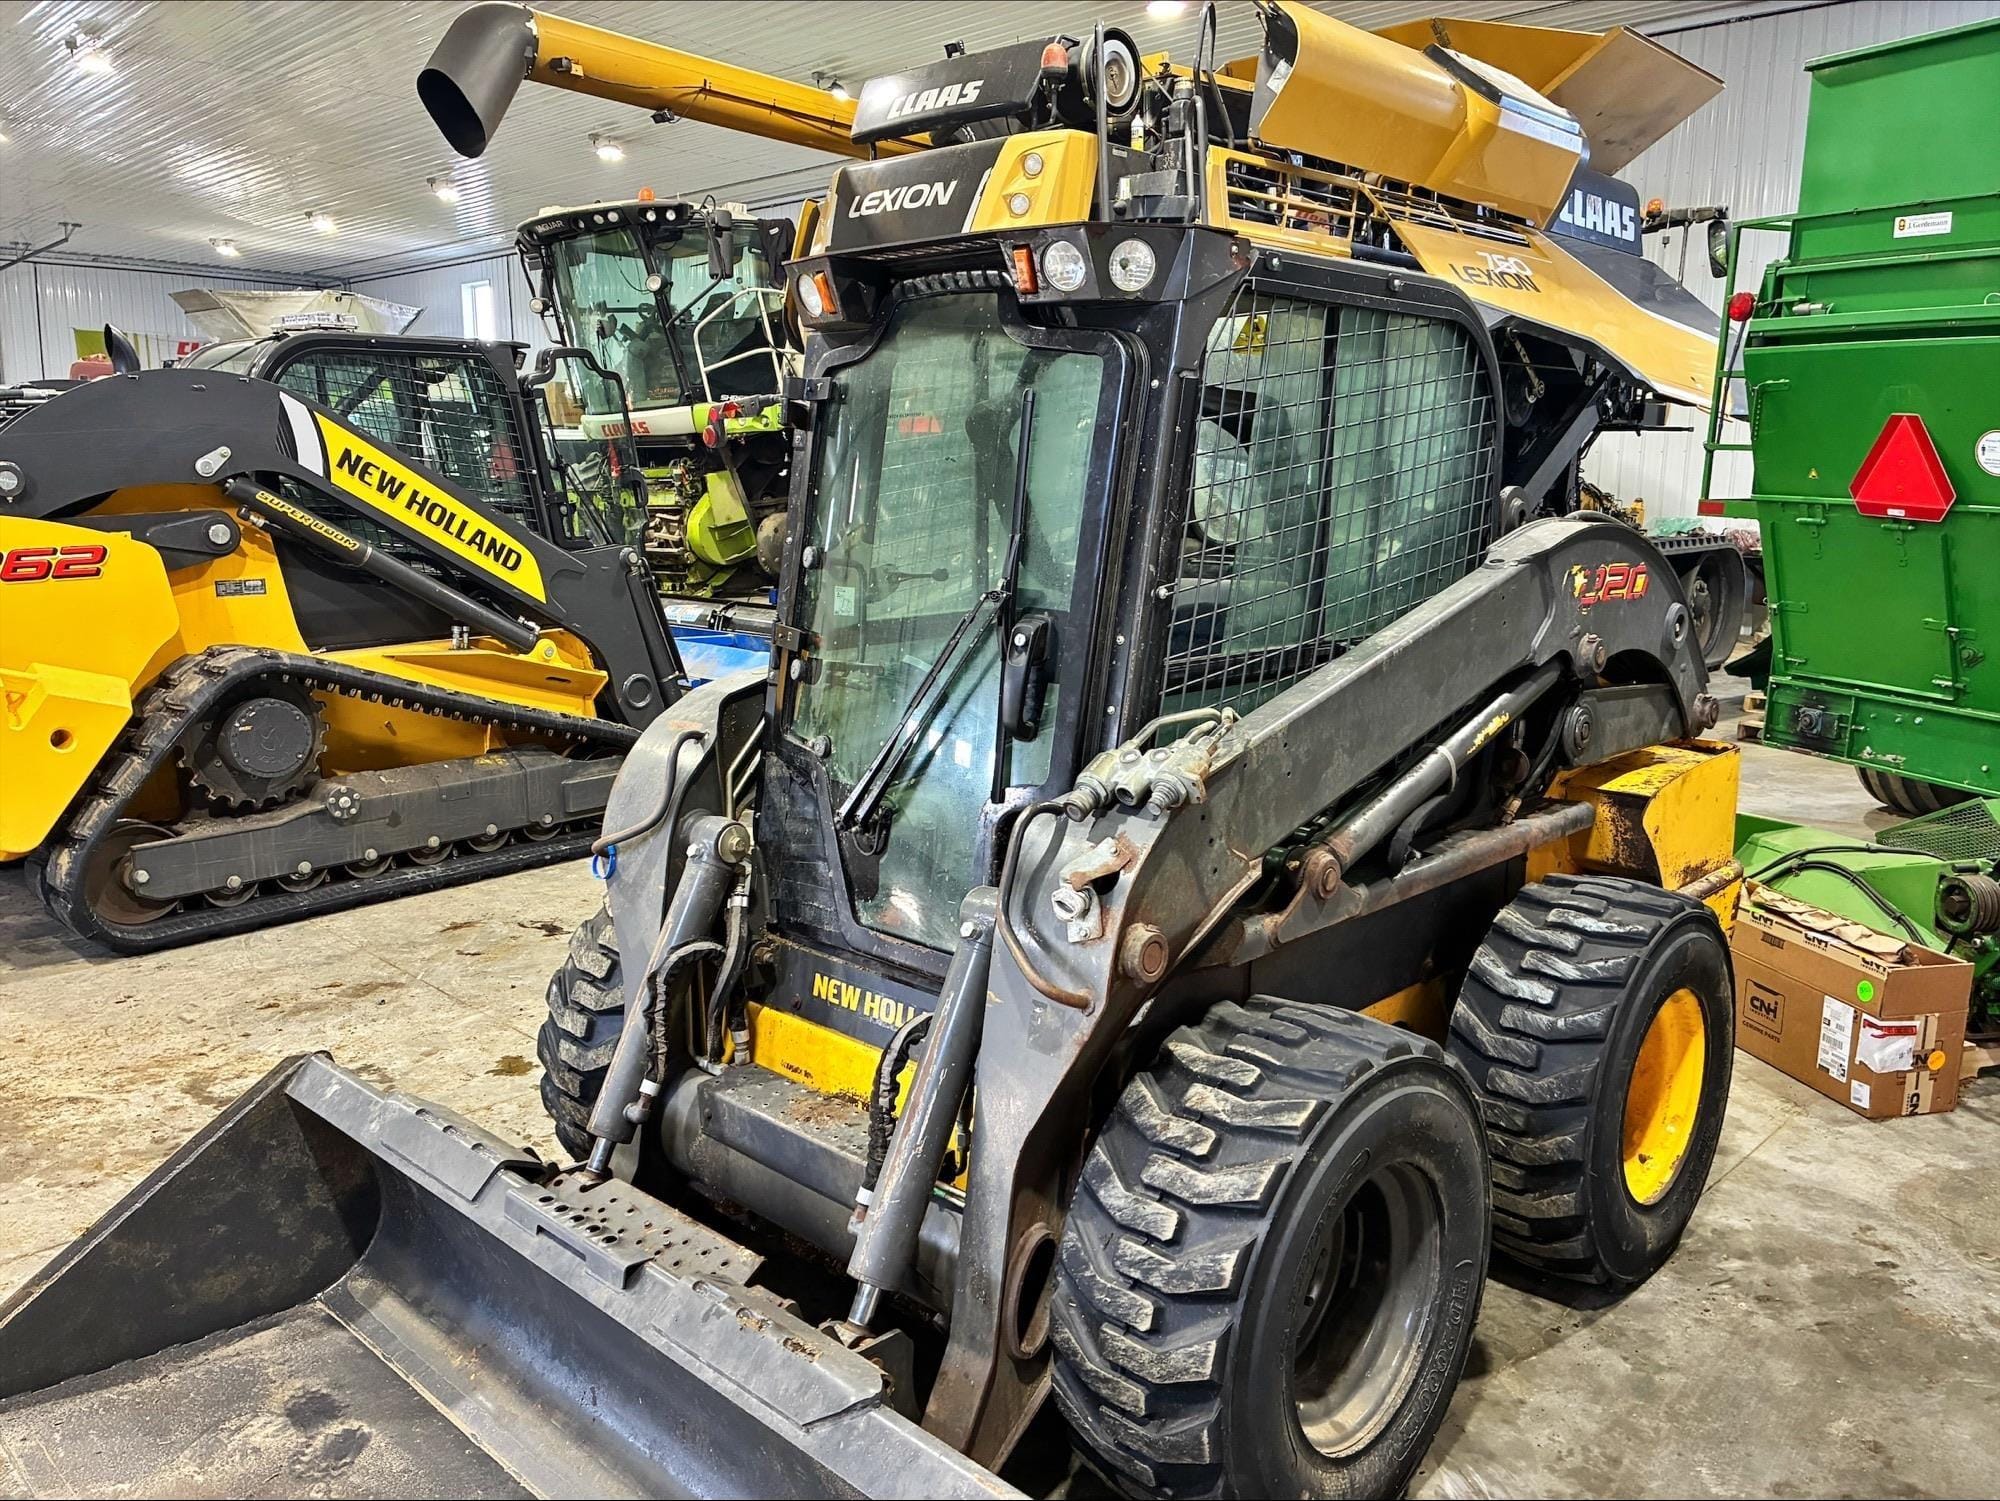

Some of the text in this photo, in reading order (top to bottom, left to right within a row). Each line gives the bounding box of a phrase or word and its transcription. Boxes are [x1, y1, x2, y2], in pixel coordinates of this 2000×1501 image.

[887, 79, 985, 120] CLAAS
[848, 179, 959, 219] LEXION
[1448, 263, 1541, 293] LEXION
[255, 490, 361, 551] SUPER BOOM
[336, 448, 523, 573] NEW HOLLAND
[0, 545, 108, 583] 62
[812, 972, 918, 1029] NEW HOLL
